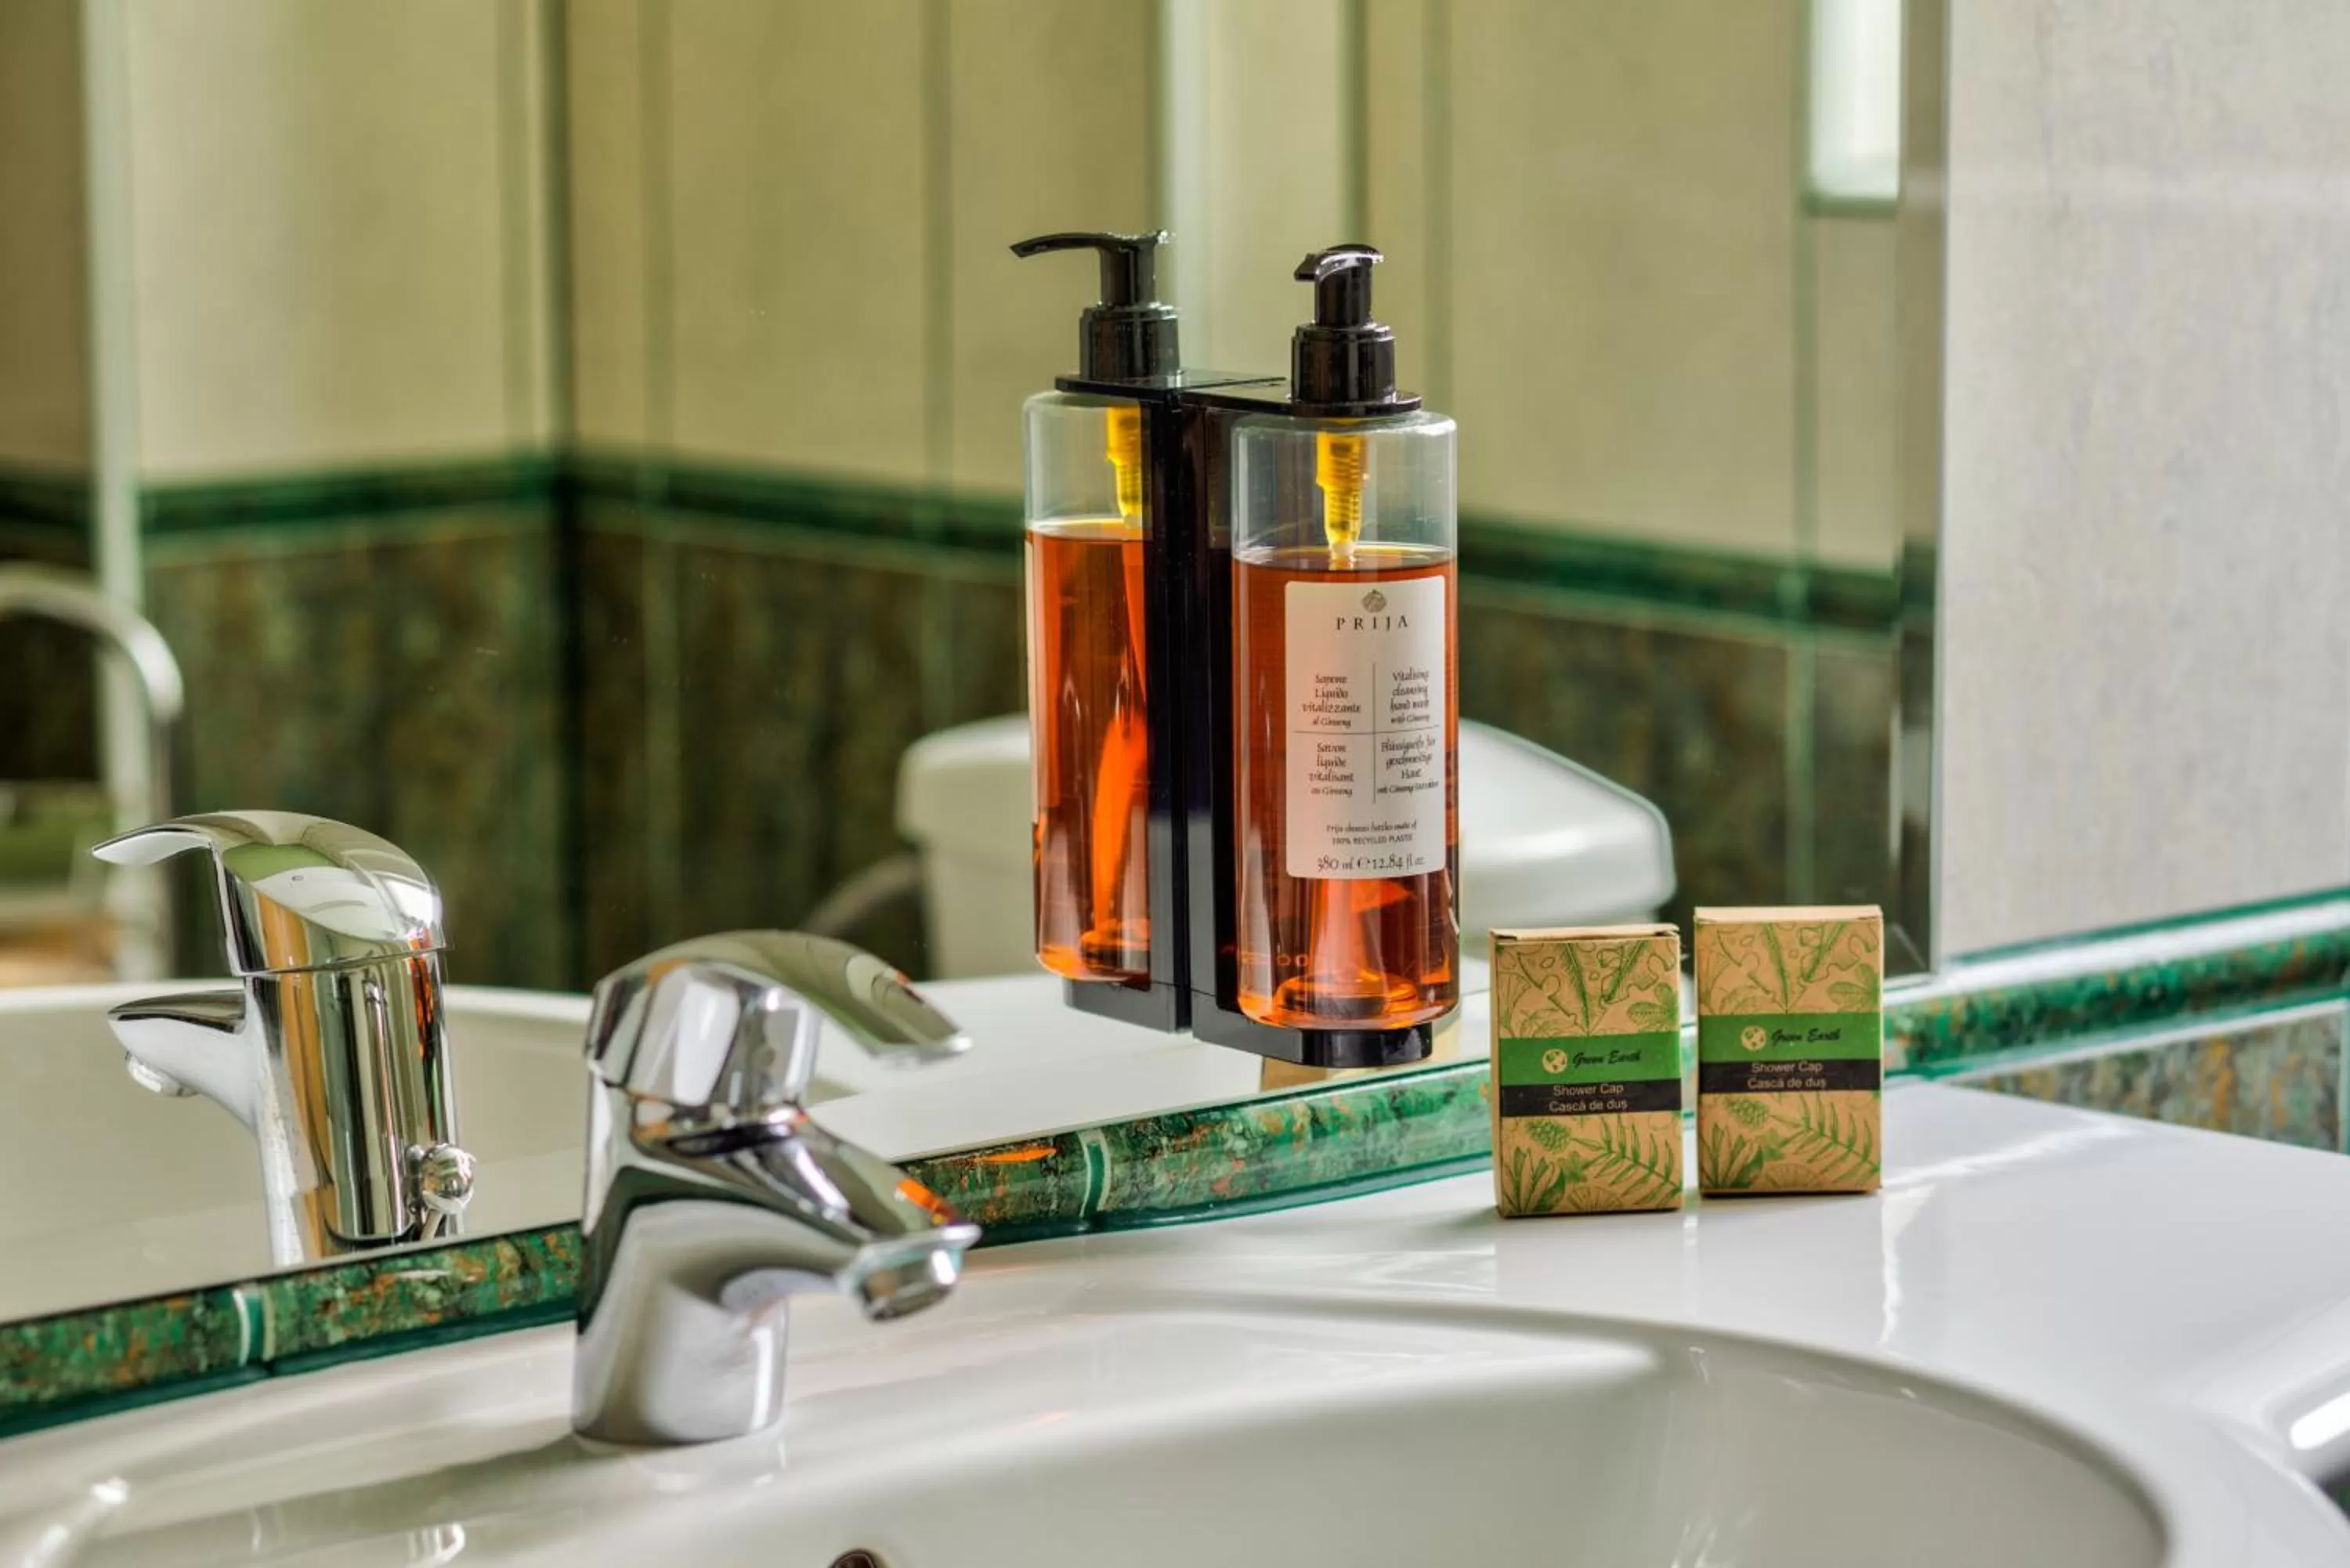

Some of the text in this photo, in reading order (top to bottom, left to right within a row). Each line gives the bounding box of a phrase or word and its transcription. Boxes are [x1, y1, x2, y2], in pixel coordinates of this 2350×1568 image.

[1336, 615, 1408, 631] PRIJA
[1315, 674, 1348, 686] Sapone
[1315, 688, 1349, 702] Liquido
[1303, 699, 1361, 714] vitalizzante
[1317, 742, 1347, 753] Savon
[1317, 754, 1347, 770] liquide
[1308, 768, 1354, 782] vitalisant
[1317, 854, 1339, 872] 380
[1342, 857, 1354, 870] ml
[1771, 1027, 1841, 1046] Green Earth
[1572, 1050, 1642, 1069] Green Earth
[1752, 1060, 1824, 1074] Shower Cap
[1553, 1082, 1624, 1097] Shower Cap
[1787, 1077, 1802, 1088] de
[1589, 1100, 1603, 1111] de
